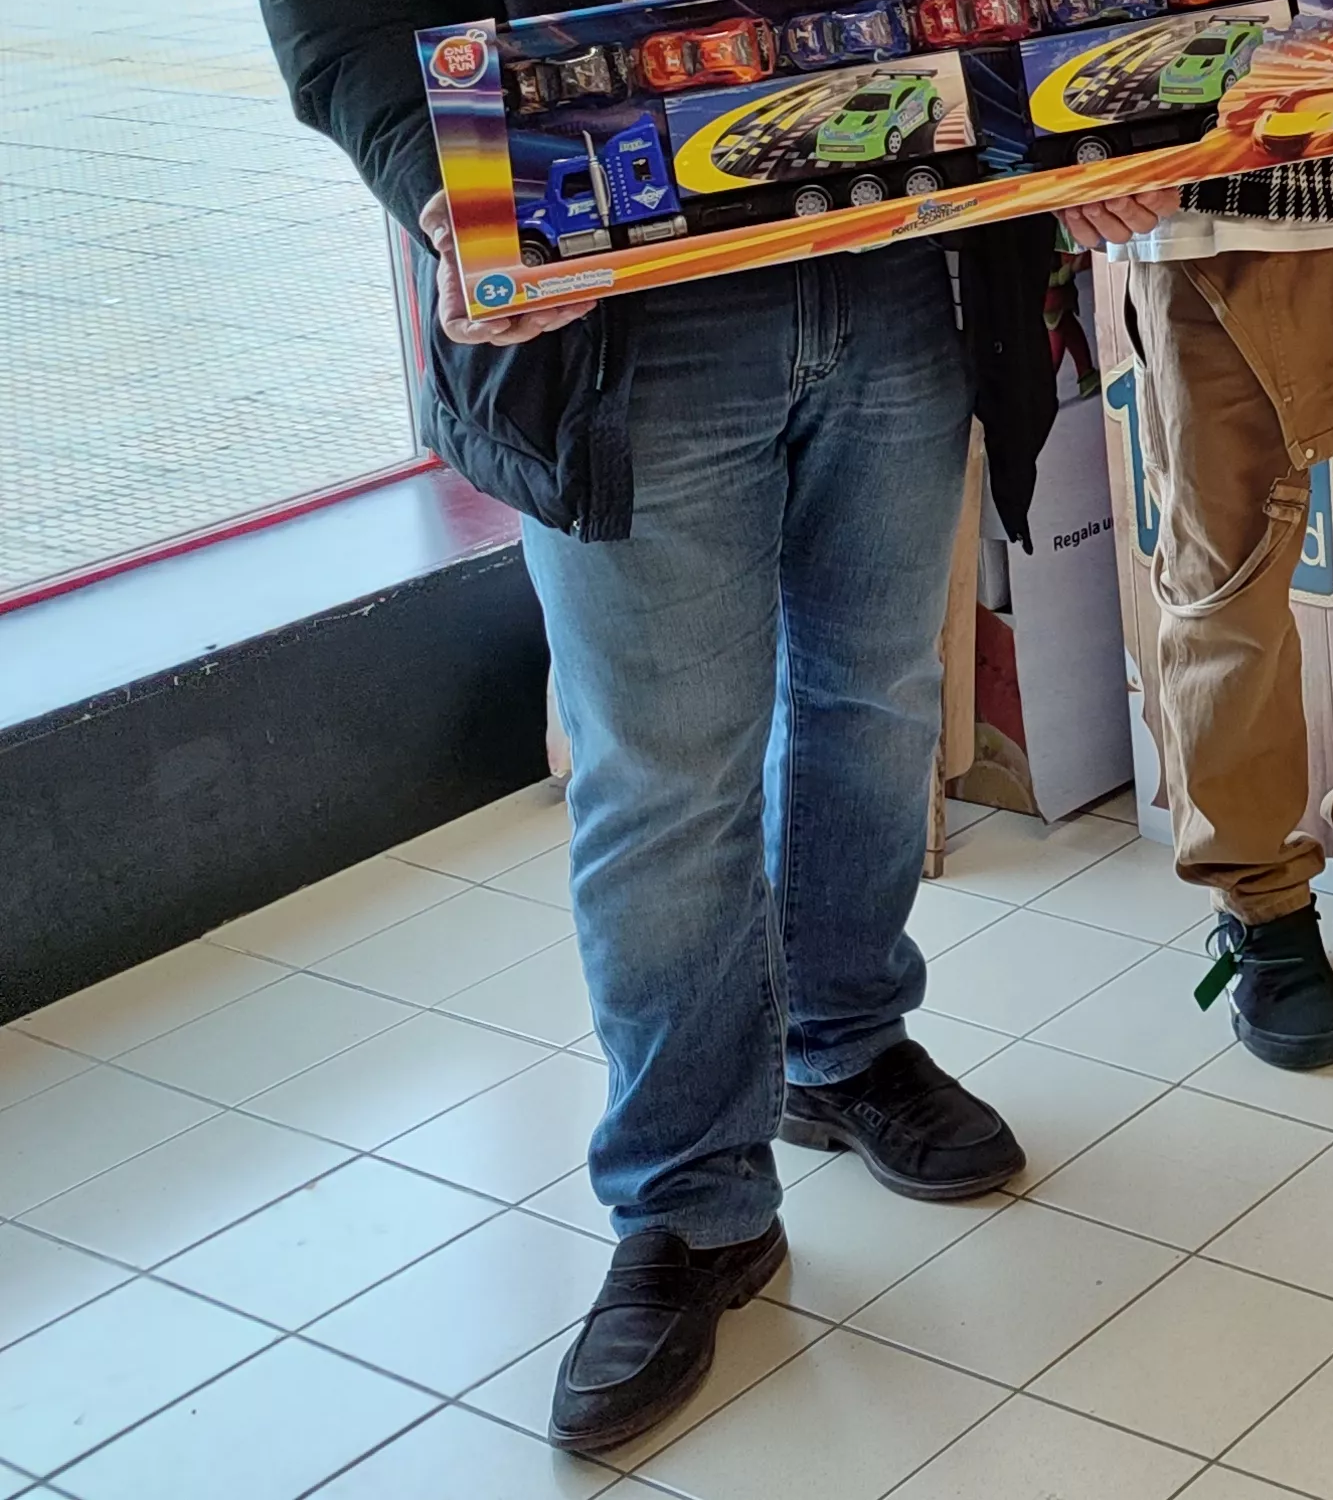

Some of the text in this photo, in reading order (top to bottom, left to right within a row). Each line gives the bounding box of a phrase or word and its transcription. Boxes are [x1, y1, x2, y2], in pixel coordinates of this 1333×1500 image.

[444, 43, 474, 55] ONE
[444, 53, 475, 64] TWO
[449, 62, 476, 73] FUN
[483, 284, 509, 300] 3+
[1052, 521, 1100, 552] Regala
